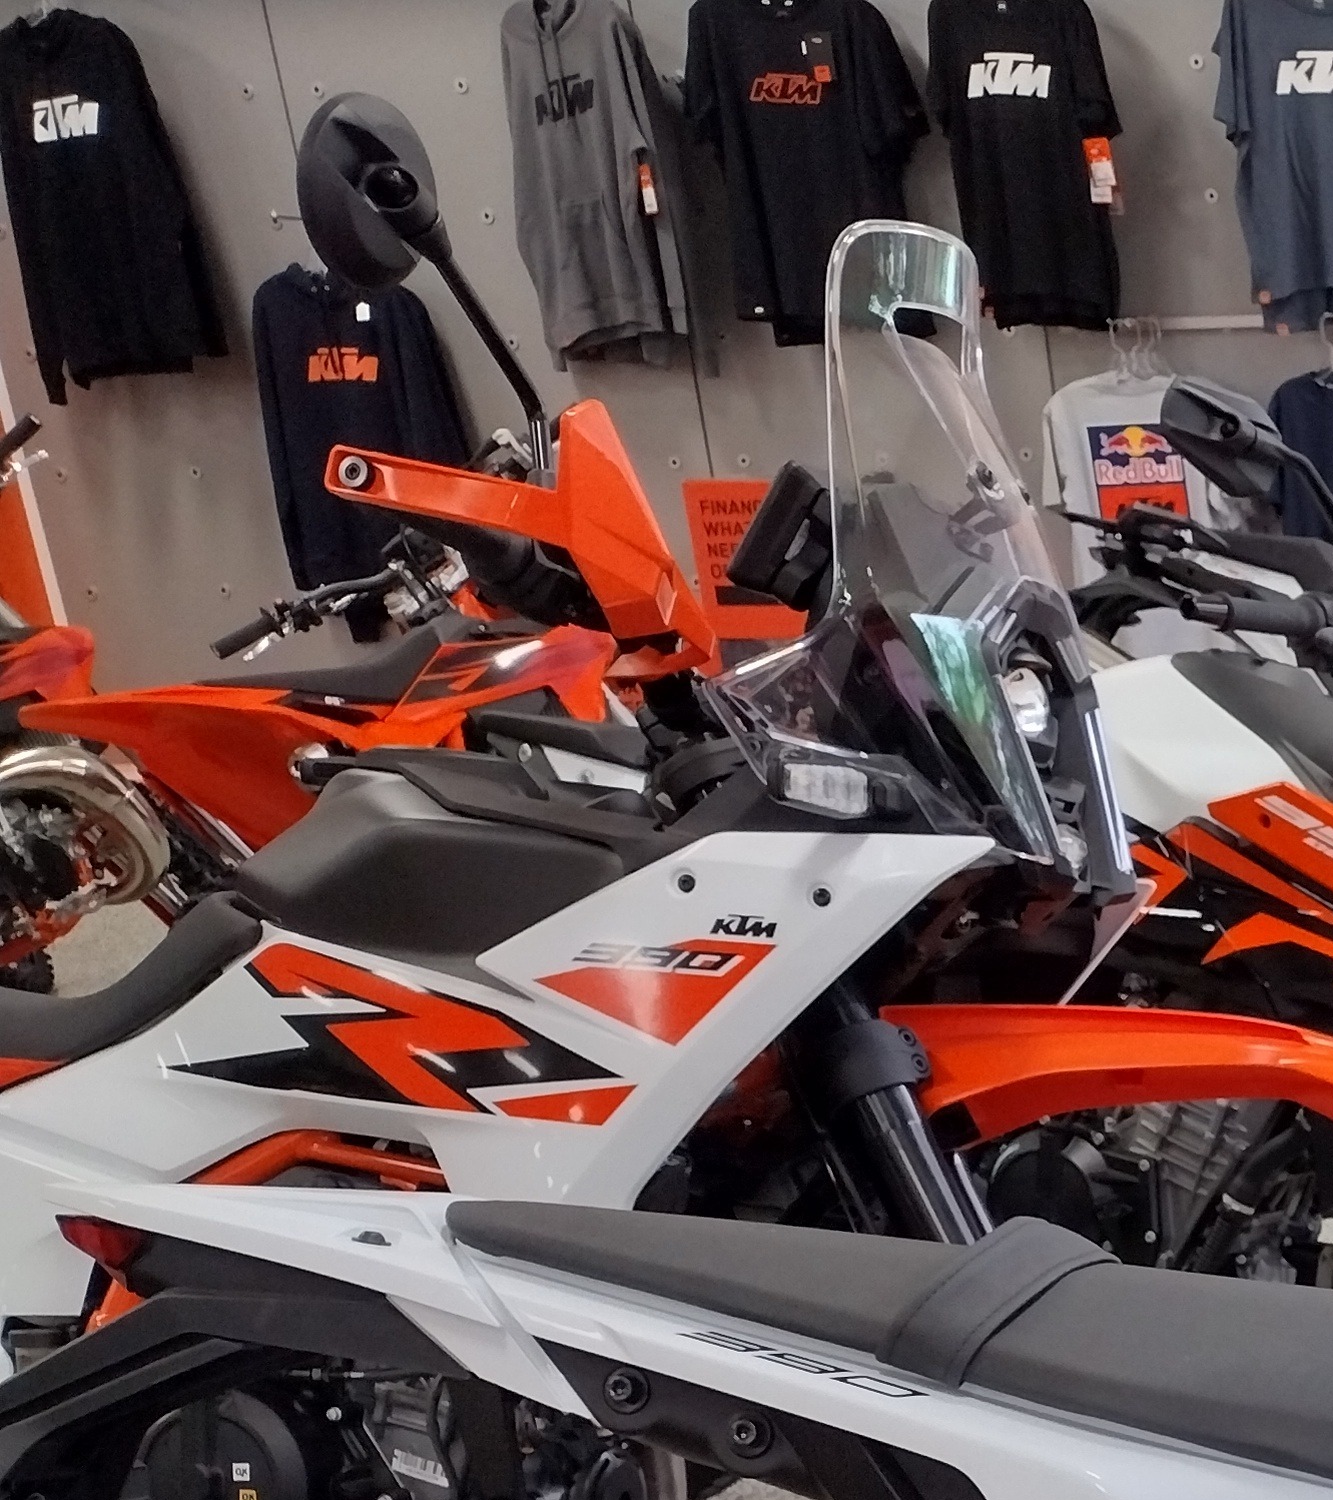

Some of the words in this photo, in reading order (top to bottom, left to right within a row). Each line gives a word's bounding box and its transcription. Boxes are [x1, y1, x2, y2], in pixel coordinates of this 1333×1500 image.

[750, 73, 823, 105] KTM
[967, 52, 1051, 99] KTM
[1096, 459, 1138, 485] Red
[1141, 455, 1183, 483] Bull
[710, 914, 777, 938] KTM
[572, 942, 746, 976] 390
[676, 1331, 930, 1398] 390
